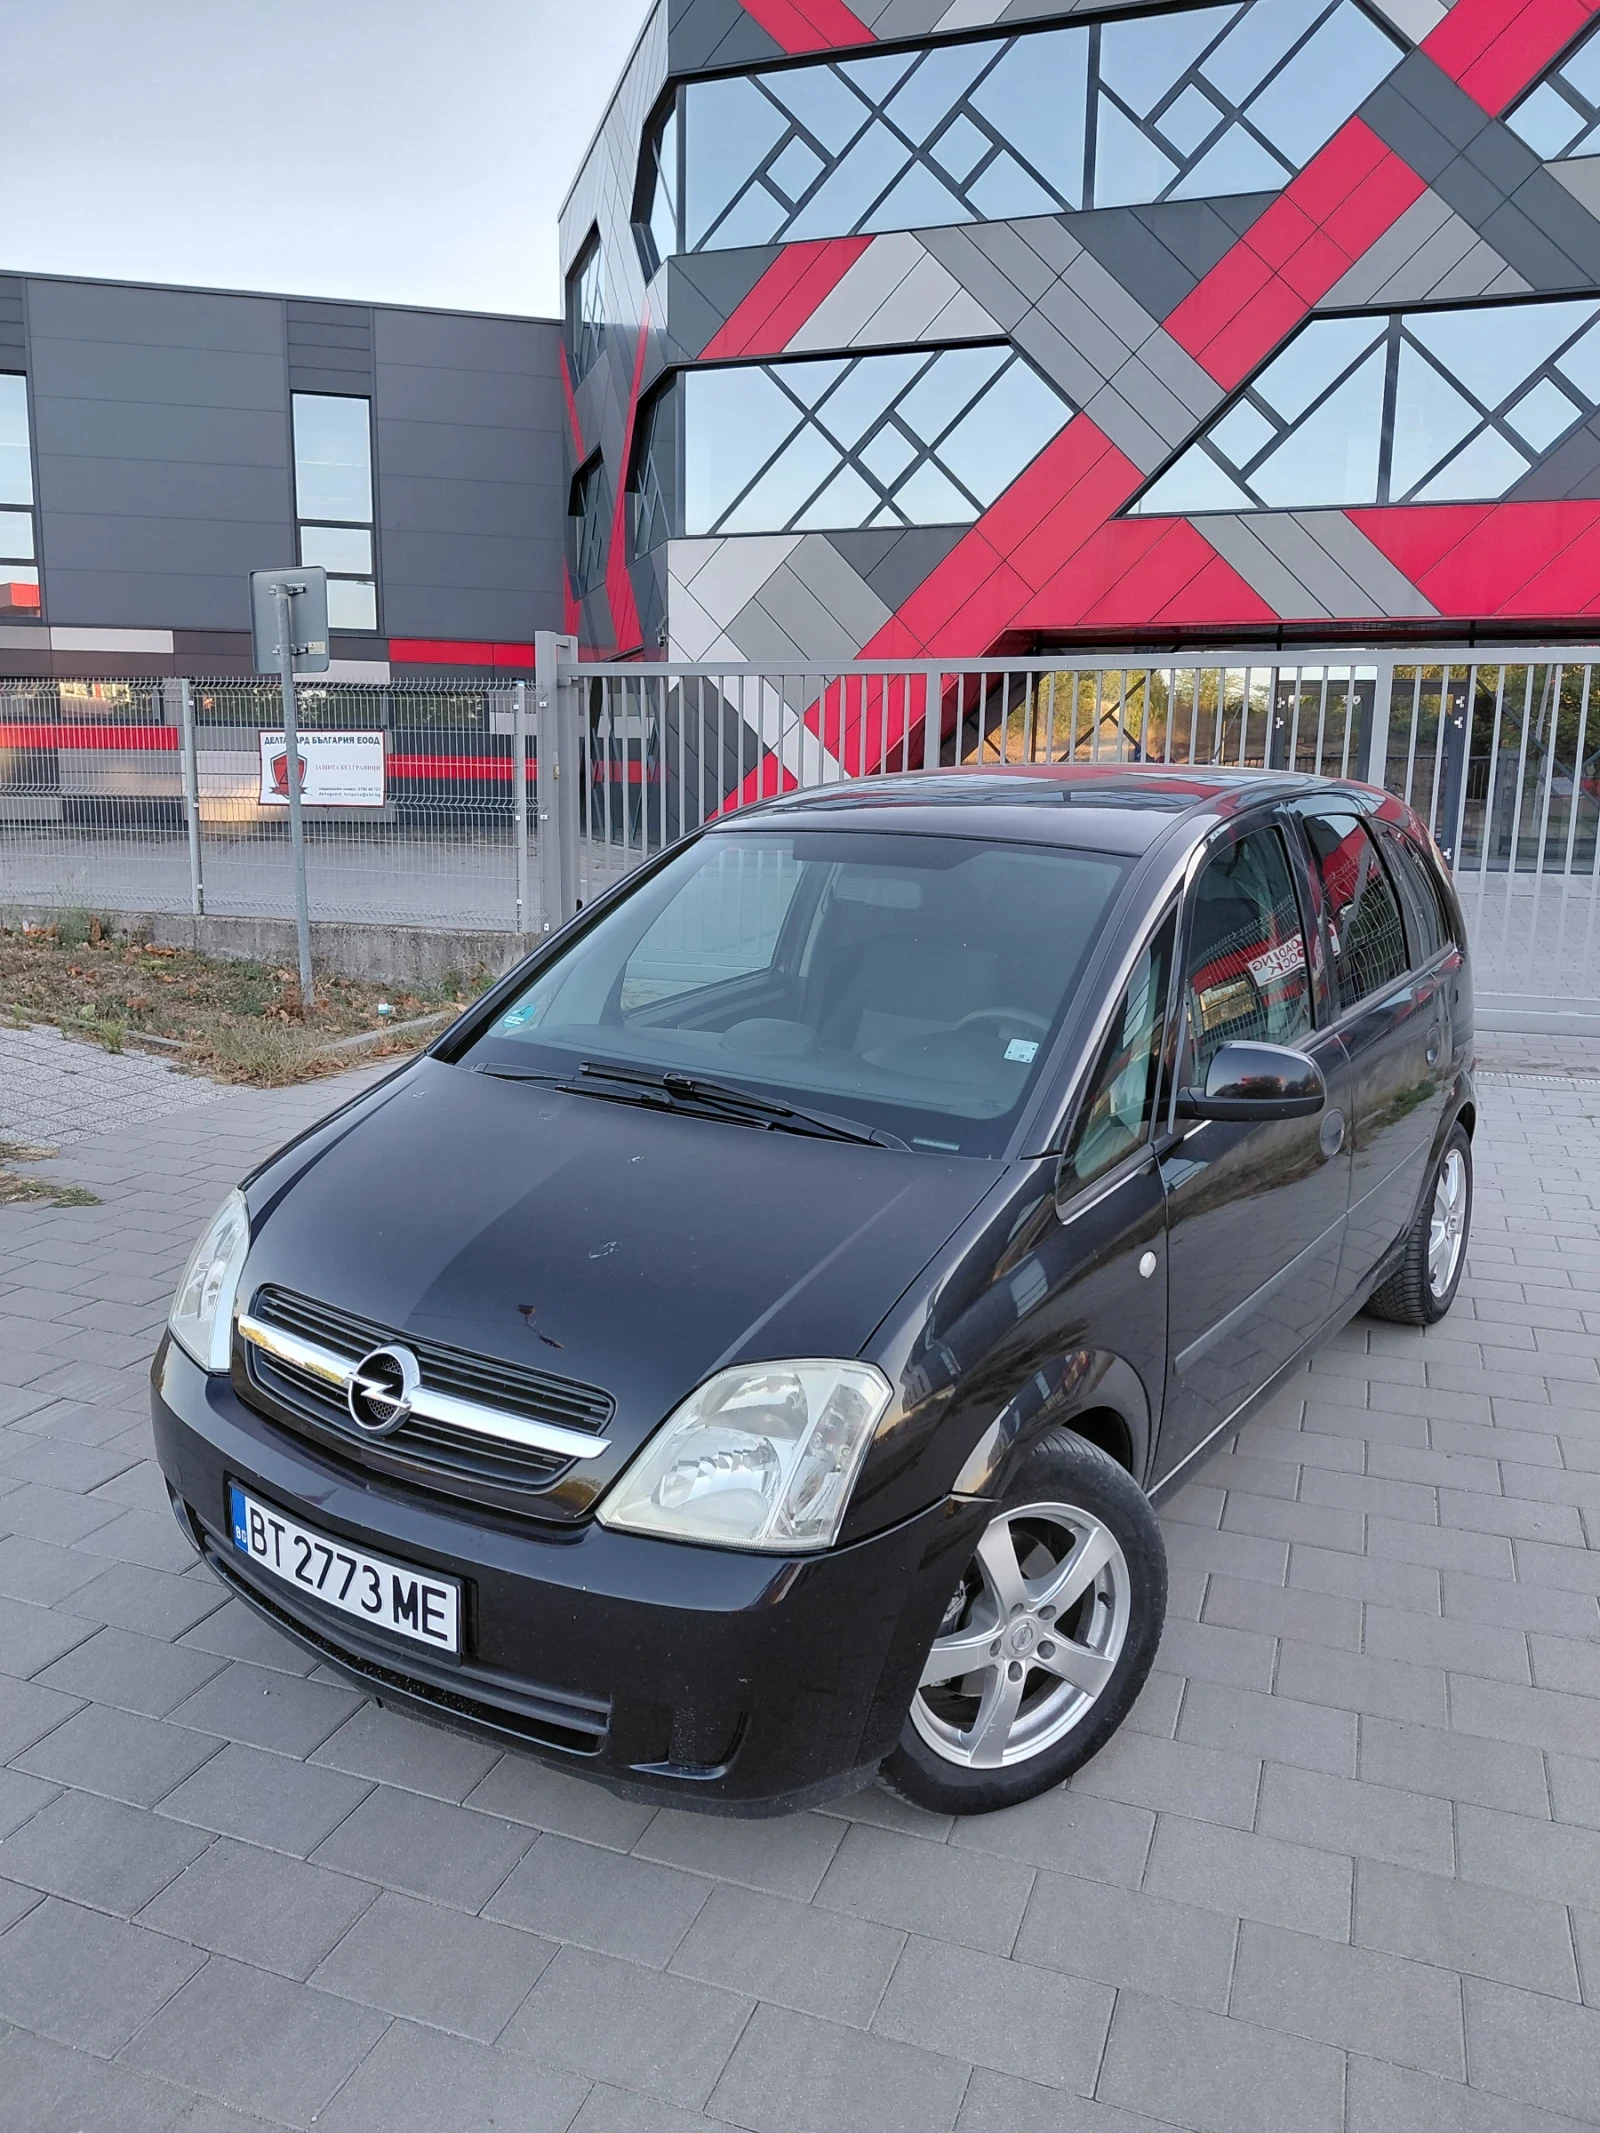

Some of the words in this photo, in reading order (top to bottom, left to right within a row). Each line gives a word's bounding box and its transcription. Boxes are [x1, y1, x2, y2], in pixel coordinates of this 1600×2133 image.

[295, 736, 310, 745] АРД
[312, 736, 354, 745] БЪЛГАРИЯ
[357, 736, 381, 745] ЕООД
[235, 1524, 247, 1544] BG
[250, 1506, 286, 1568] BT
[294, 1535, 382, 1614] 2773
[392, 1574, 448, 1642] ME
